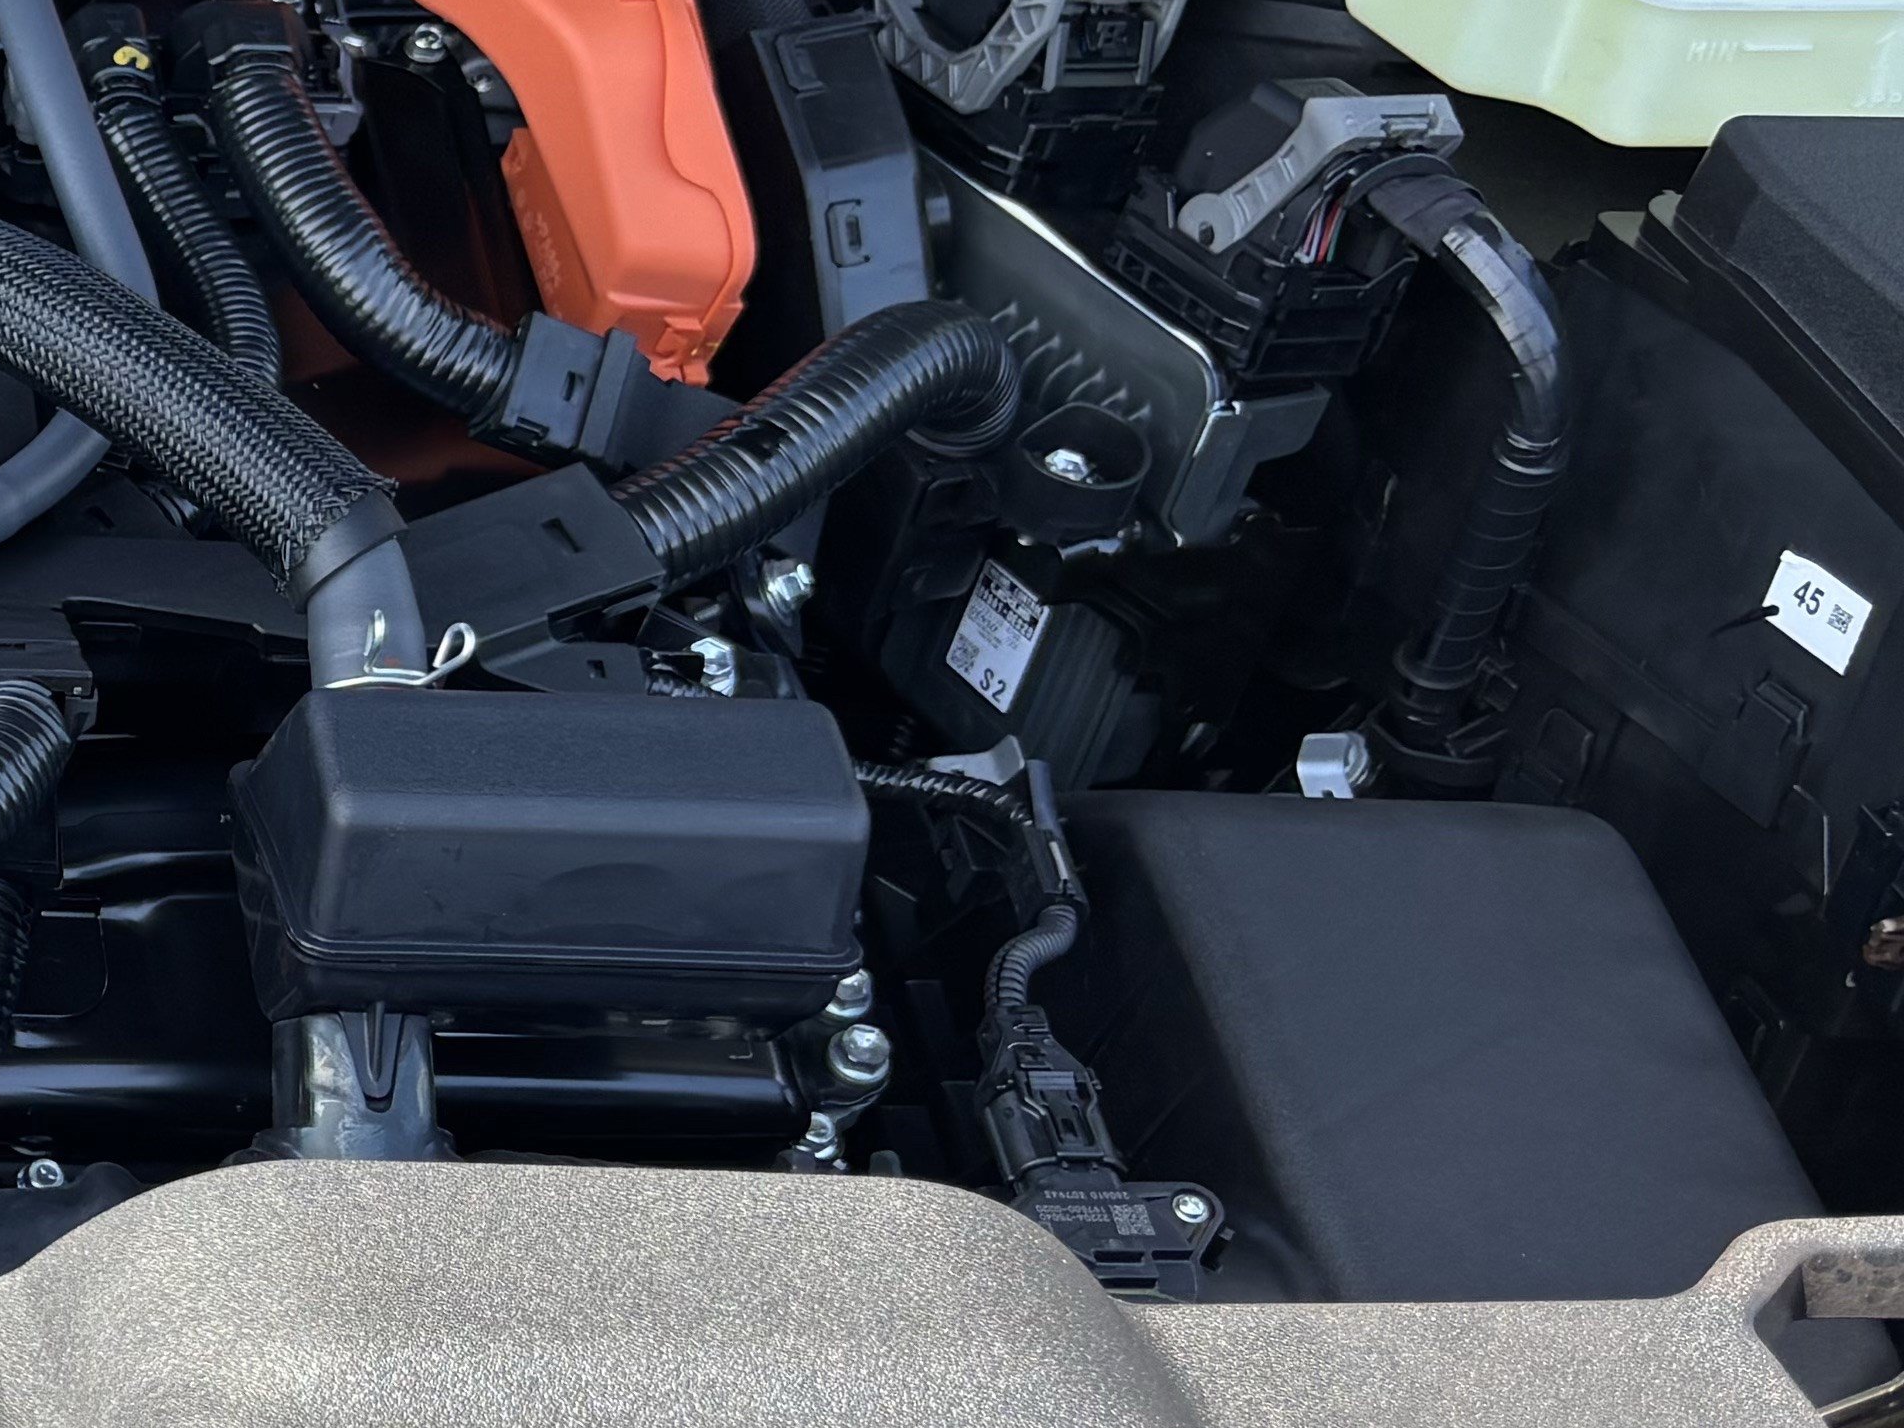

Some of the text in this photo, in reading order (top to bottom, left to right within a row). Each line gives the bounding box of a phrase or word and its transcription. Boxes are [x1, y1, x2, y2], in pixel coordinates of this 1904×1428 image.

[1686, 41, 1738, 63] MIN
[1792, 580, 1825, 615] 45
[979, 667, 1007, 703] S2
